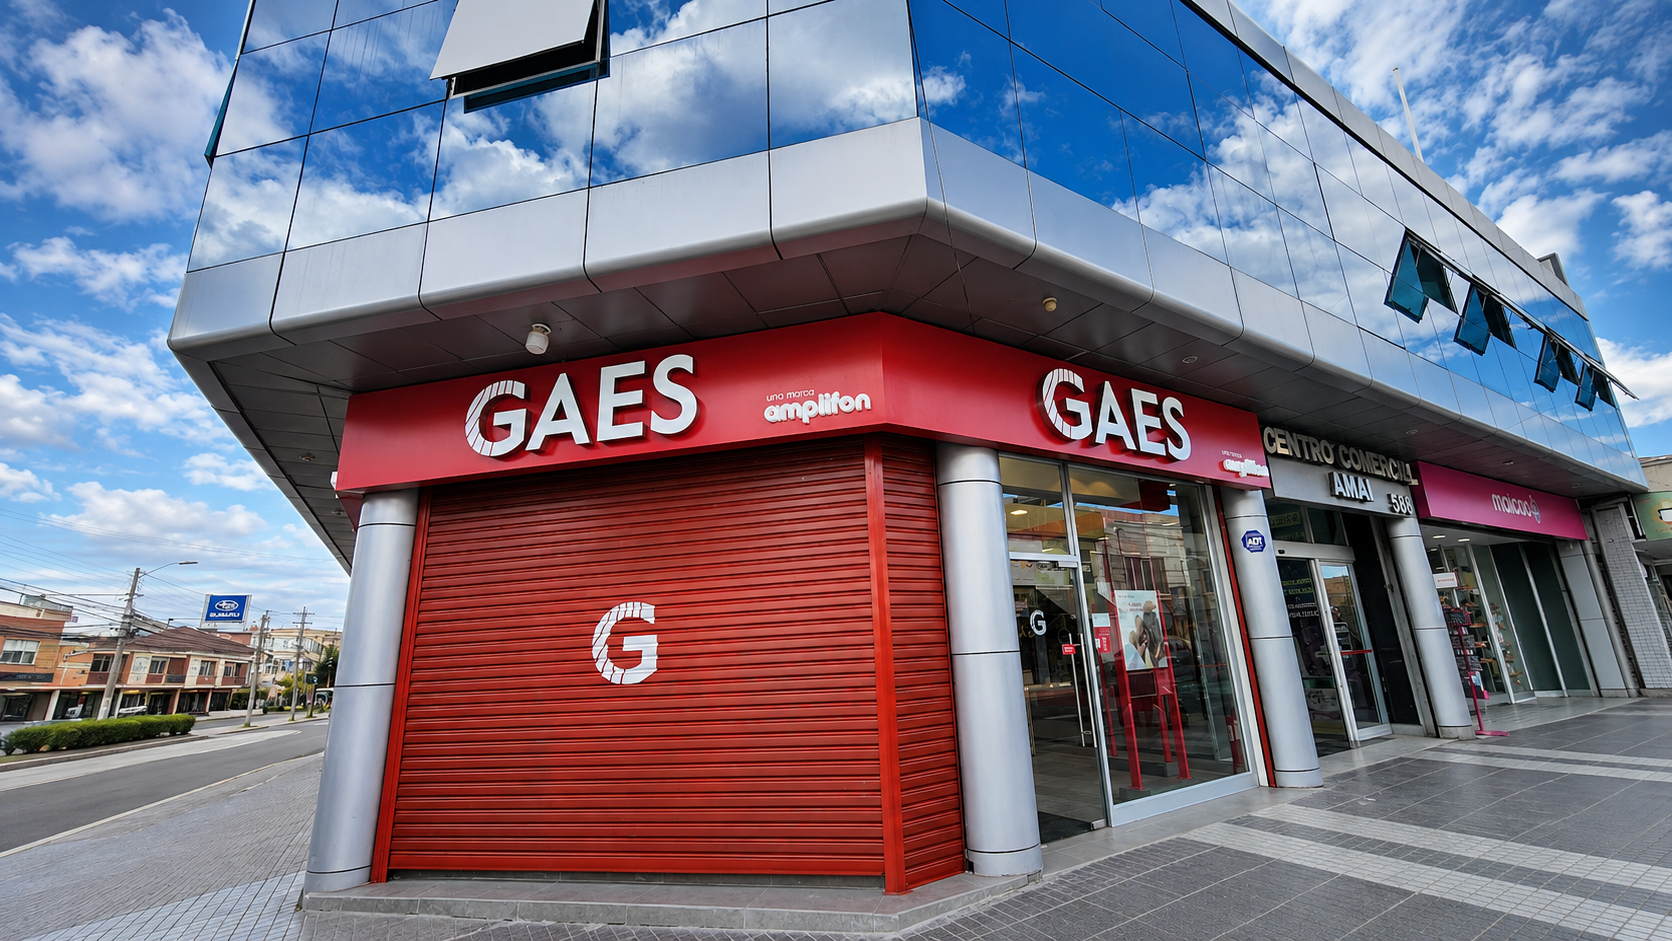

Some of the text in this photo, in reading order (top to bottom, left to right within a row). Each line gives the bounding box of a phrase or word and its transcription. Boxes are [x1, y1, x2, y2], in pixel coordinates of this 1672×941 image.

[465, 354, 698, 457] GAES
[764, 391, 871, 424] amplifon
[766, 389, 814, 401] una marca
[1041, 368, 1191, 461] GAES
[1263, 426, 1335, 465] CENTRO
[1333, 471, 1374, 501] AMAI
[1247, 536, 1263, 547] ADT
[1029, 609, 1047, 636] G
[592, 601, 659, 685] G
